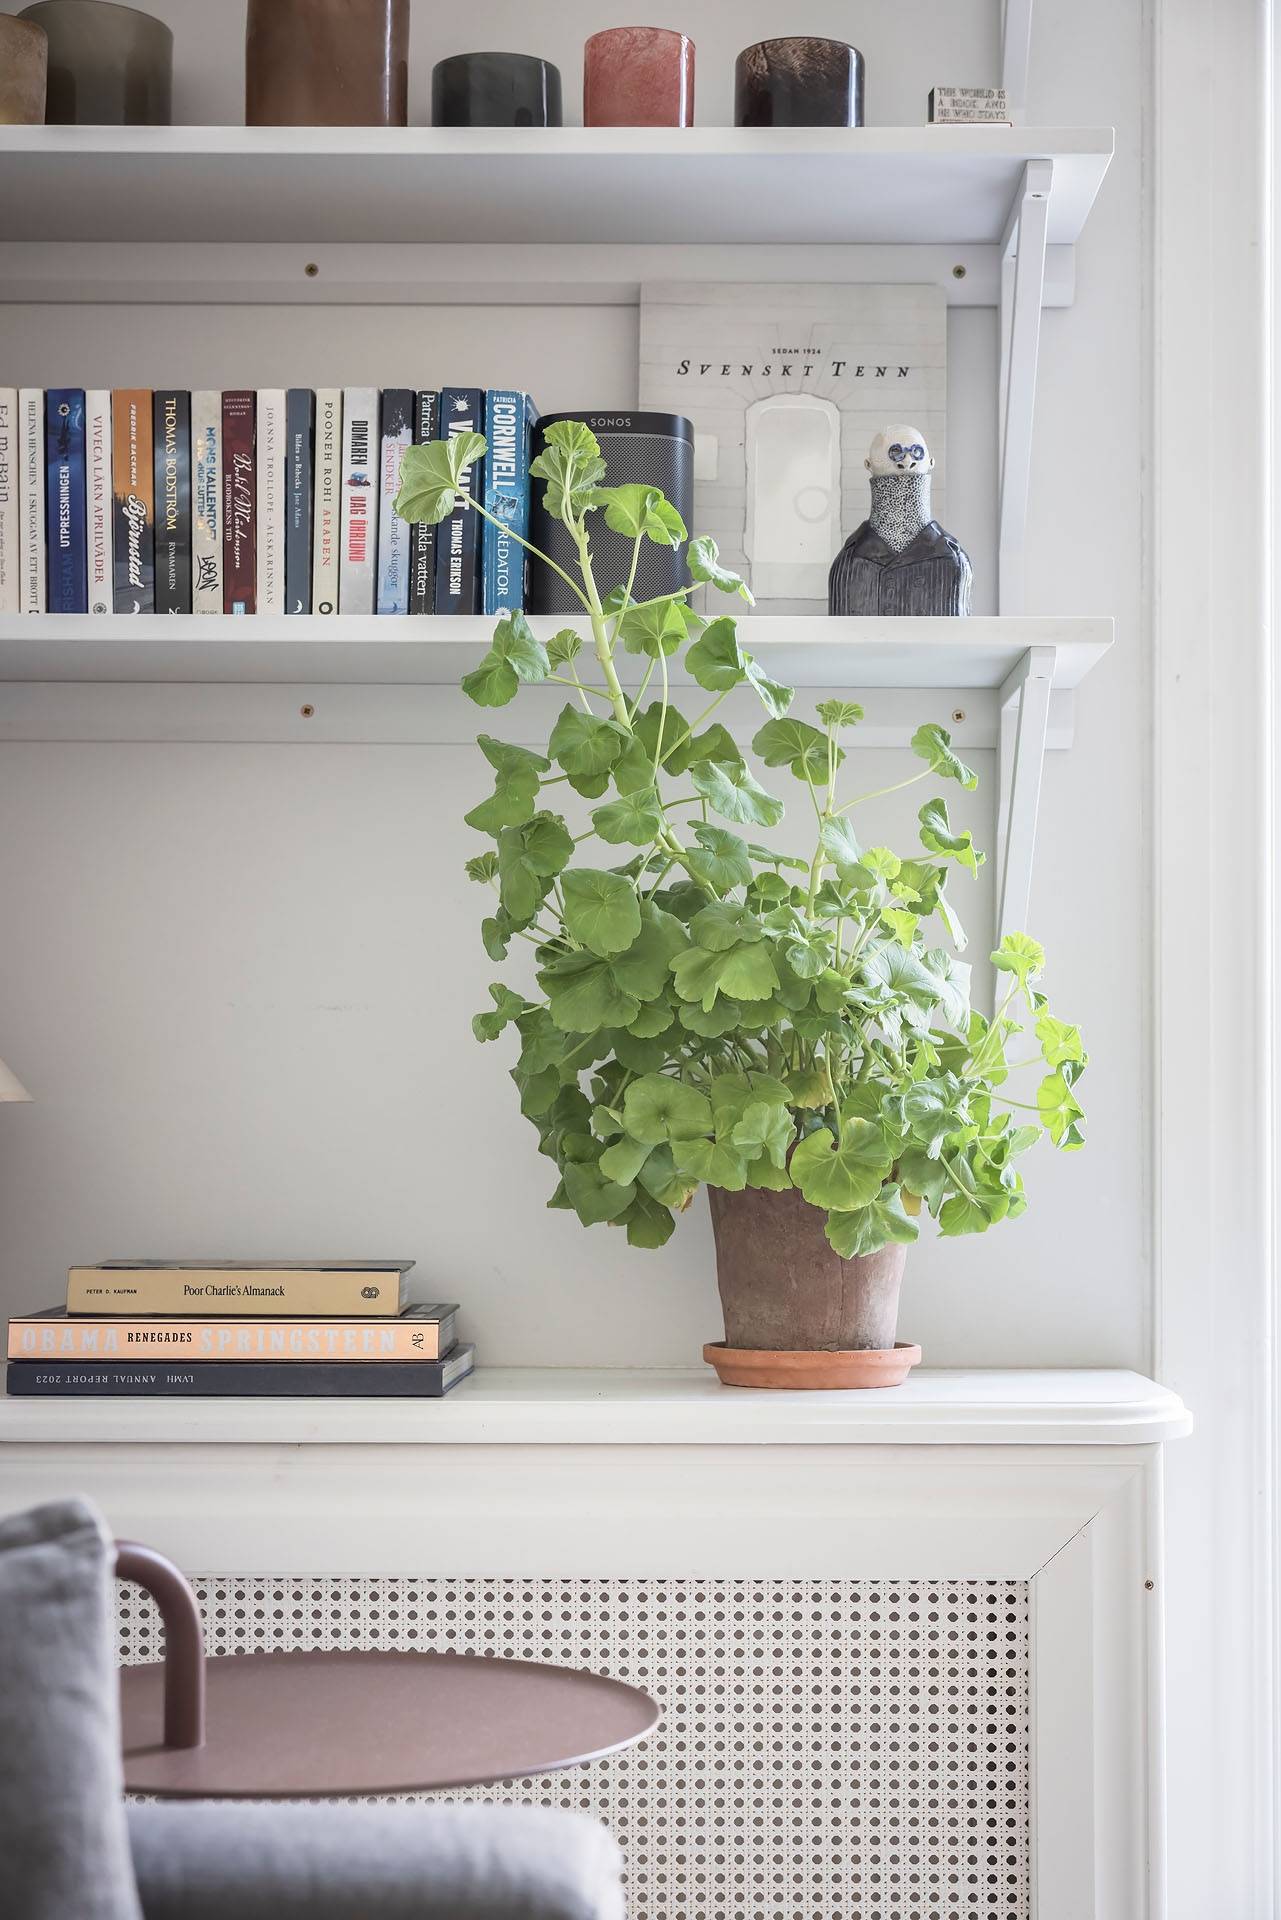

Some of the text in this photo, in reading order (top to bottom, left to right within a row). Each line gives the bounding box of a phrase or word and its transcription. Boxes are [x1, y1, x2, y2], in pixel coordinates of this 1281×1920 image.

[677, 360, 909, 377] SVENSKT TENN
[28, 401, 36, 436] HELENA
[266, 407, 274, 451] JOANNA
[421, 394, 435, 437] Patricia
[590, 418, 631, 427] SONOS
[28, 438, 37, 486] HENSCHEN
[492, 404, 516, 490] CORNWELL
[233, 453, 251, 495] Bodil
[266, 457, 274, 513] TROLLOPE
[294, 463, 302, 489] Rebecka
[322, 402, 333, 567] POONEH ROHI ARABEN
[385, 443, 395, 495] SENDKER
[60, 465, 70, 547] UTPRESSNINGEN
[93, 416, 105, 583] VIVECA LÄRN APRILVÄDER
[165, 398, 180, 590] THOMAS BODSTRÖM RYMMAREN
[348, 421, 368, 562] DOMAREN DAG ÖHRLUND
[28, 498, 38, 540] SKUGGAN
[29, 543, 38, 553] AV
[122, 494, 147, 588] Björnstad
[449, 519, 463, 595] THOMAS ERIKSON
[29, 556, 38, 573] ETT
[388, 550, 400, 588] skuggor
[417, 554, 428, 596] vatten
[29, 576, 38, 605] BROTT
[183, 1285, 285, 1296] Poor Charlie's Almanack
[21, 1327, 397, 1352] OBAMA RENEGADES SPRINGSTEEN
[36, 1375, 194, 1383] LVMH ANNUAL REPORT 2023
